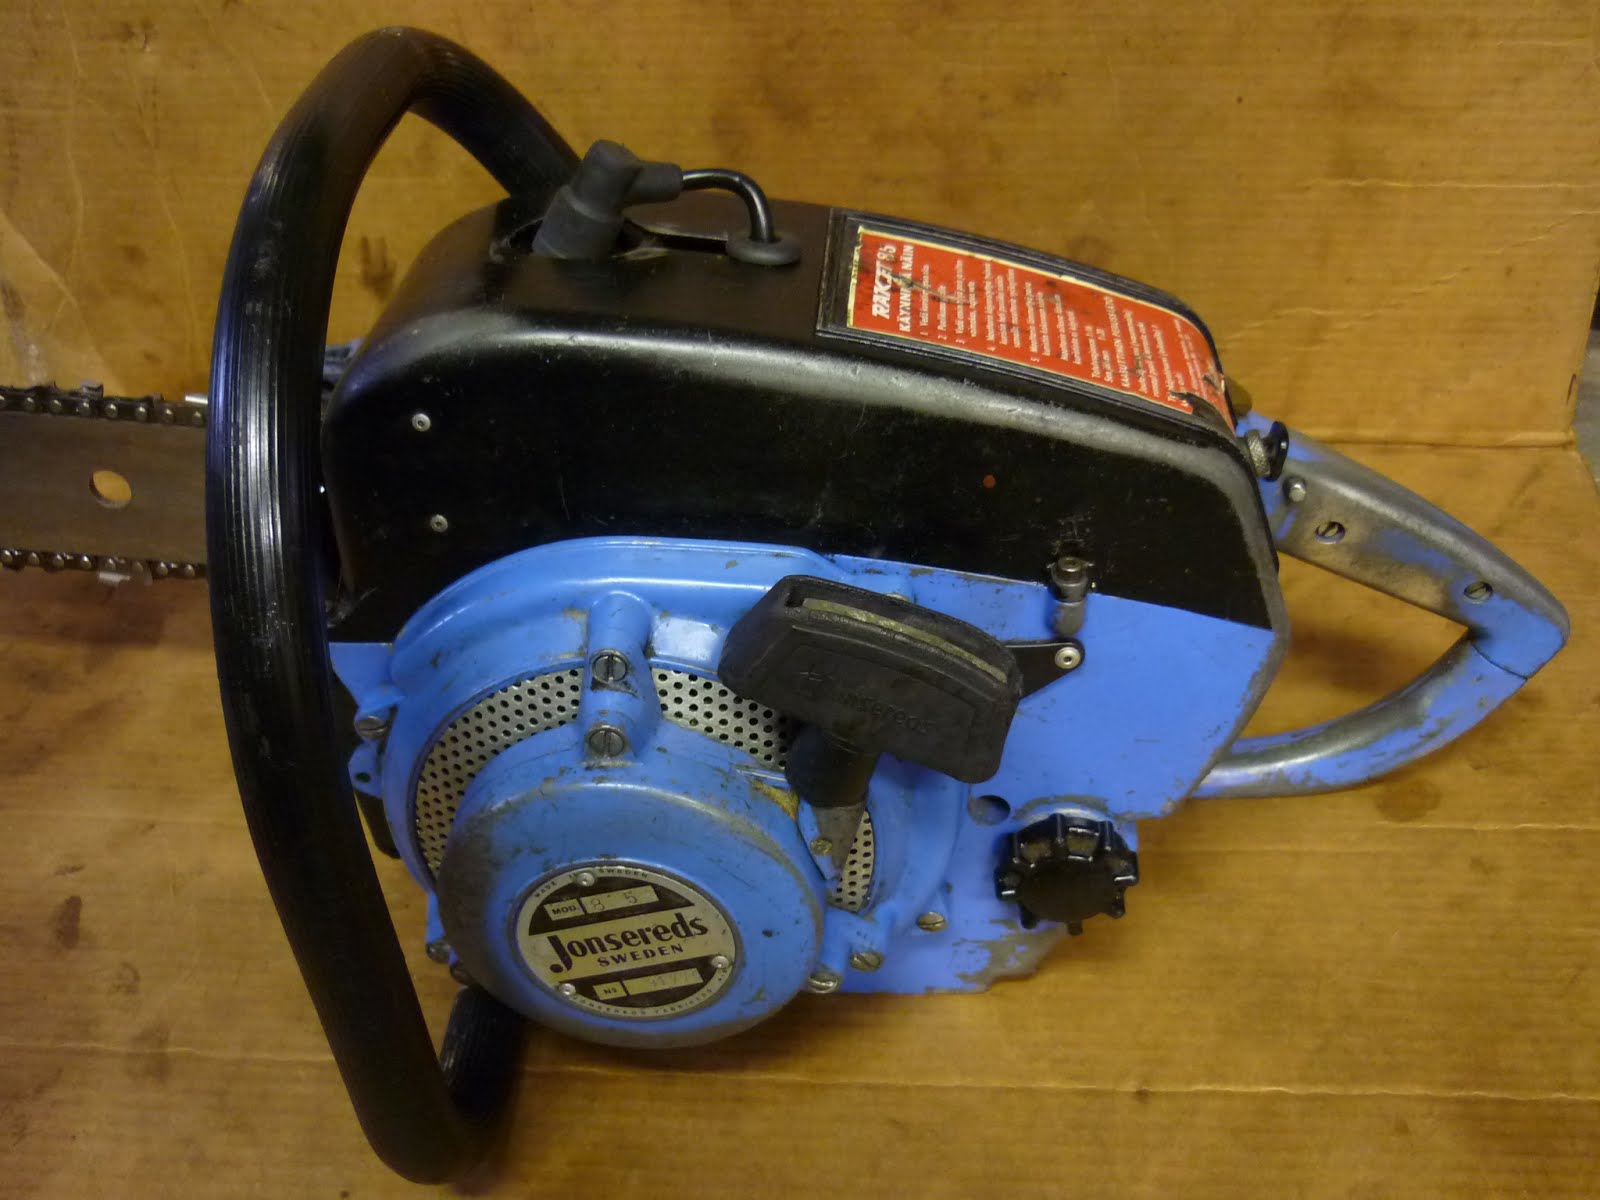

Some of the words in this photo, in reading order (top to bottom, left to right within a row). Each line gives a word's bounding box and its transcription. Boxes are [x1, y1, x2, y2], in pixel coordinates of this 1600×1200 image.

[900, 244, 914, 271] NÄIN
[897, 273, 912, 332] KÄYNNIÄ
[547, 912, 709, 973] Jonsereds
[597, 943, 684, 967] SWEDEN
